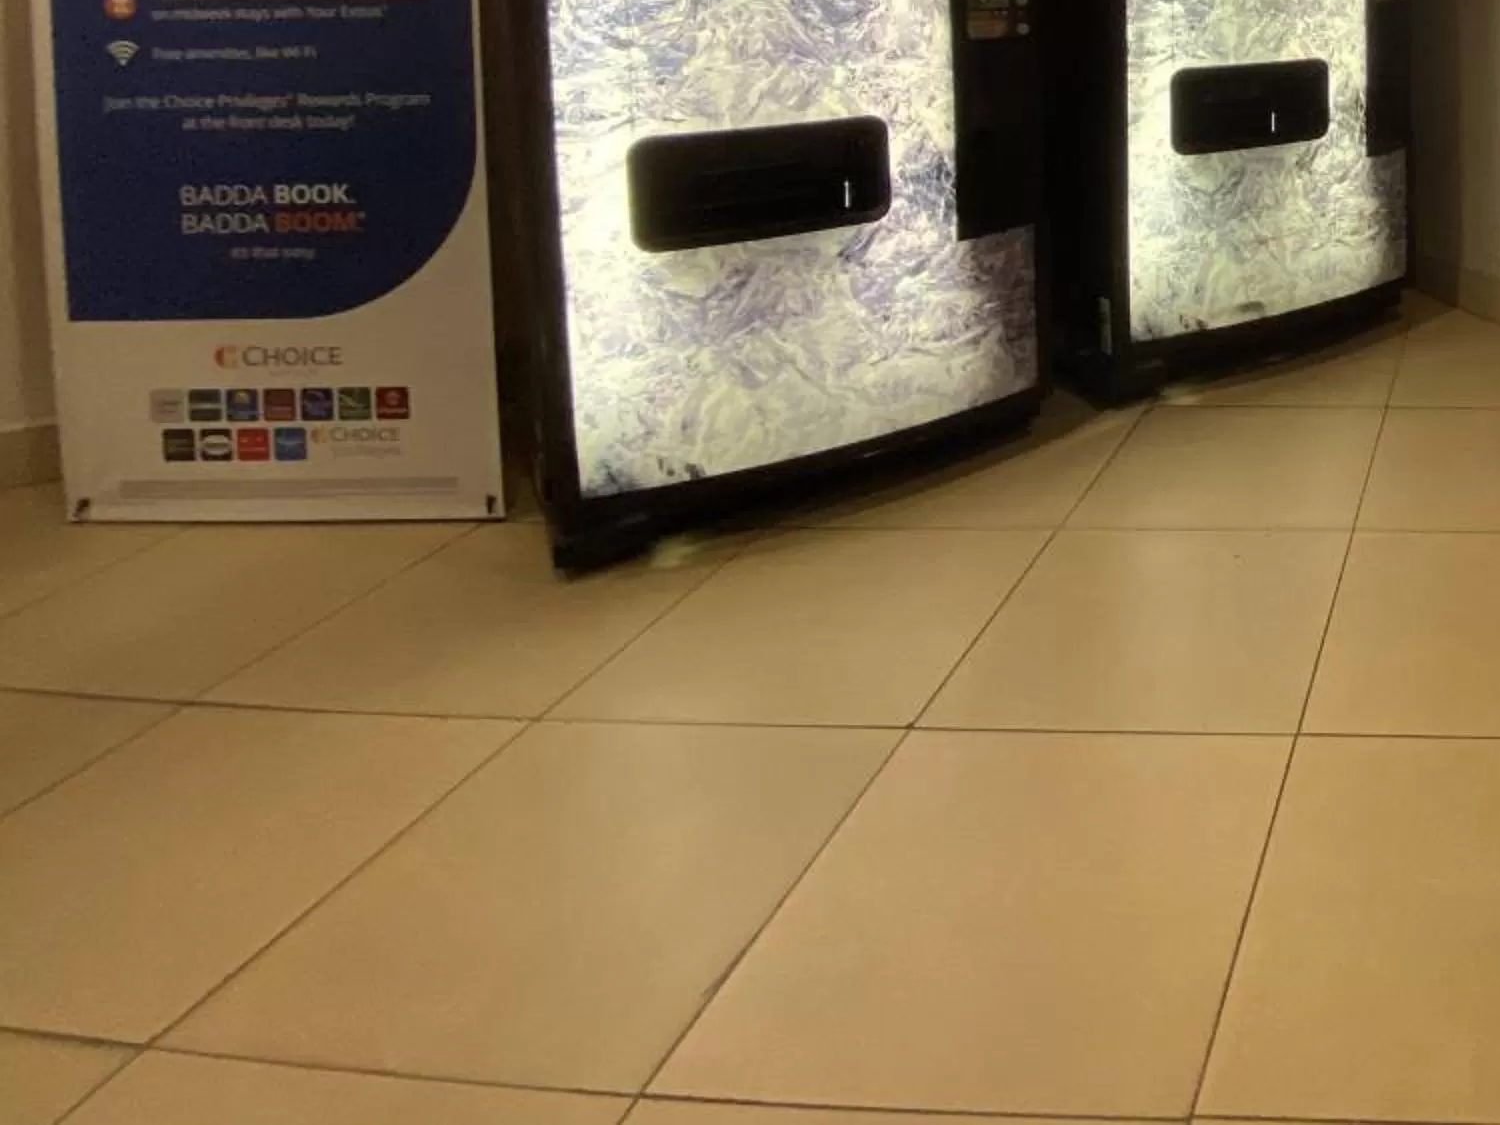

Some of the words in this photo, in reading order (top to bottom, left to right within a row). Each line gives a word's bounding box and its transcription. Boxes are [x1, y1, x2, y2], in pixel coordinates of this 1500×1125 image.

[179, 184, 269, 206] BADDA
[180, 213, 271, 235] BADDA
[242, 346, 345, 367] CHOICE
